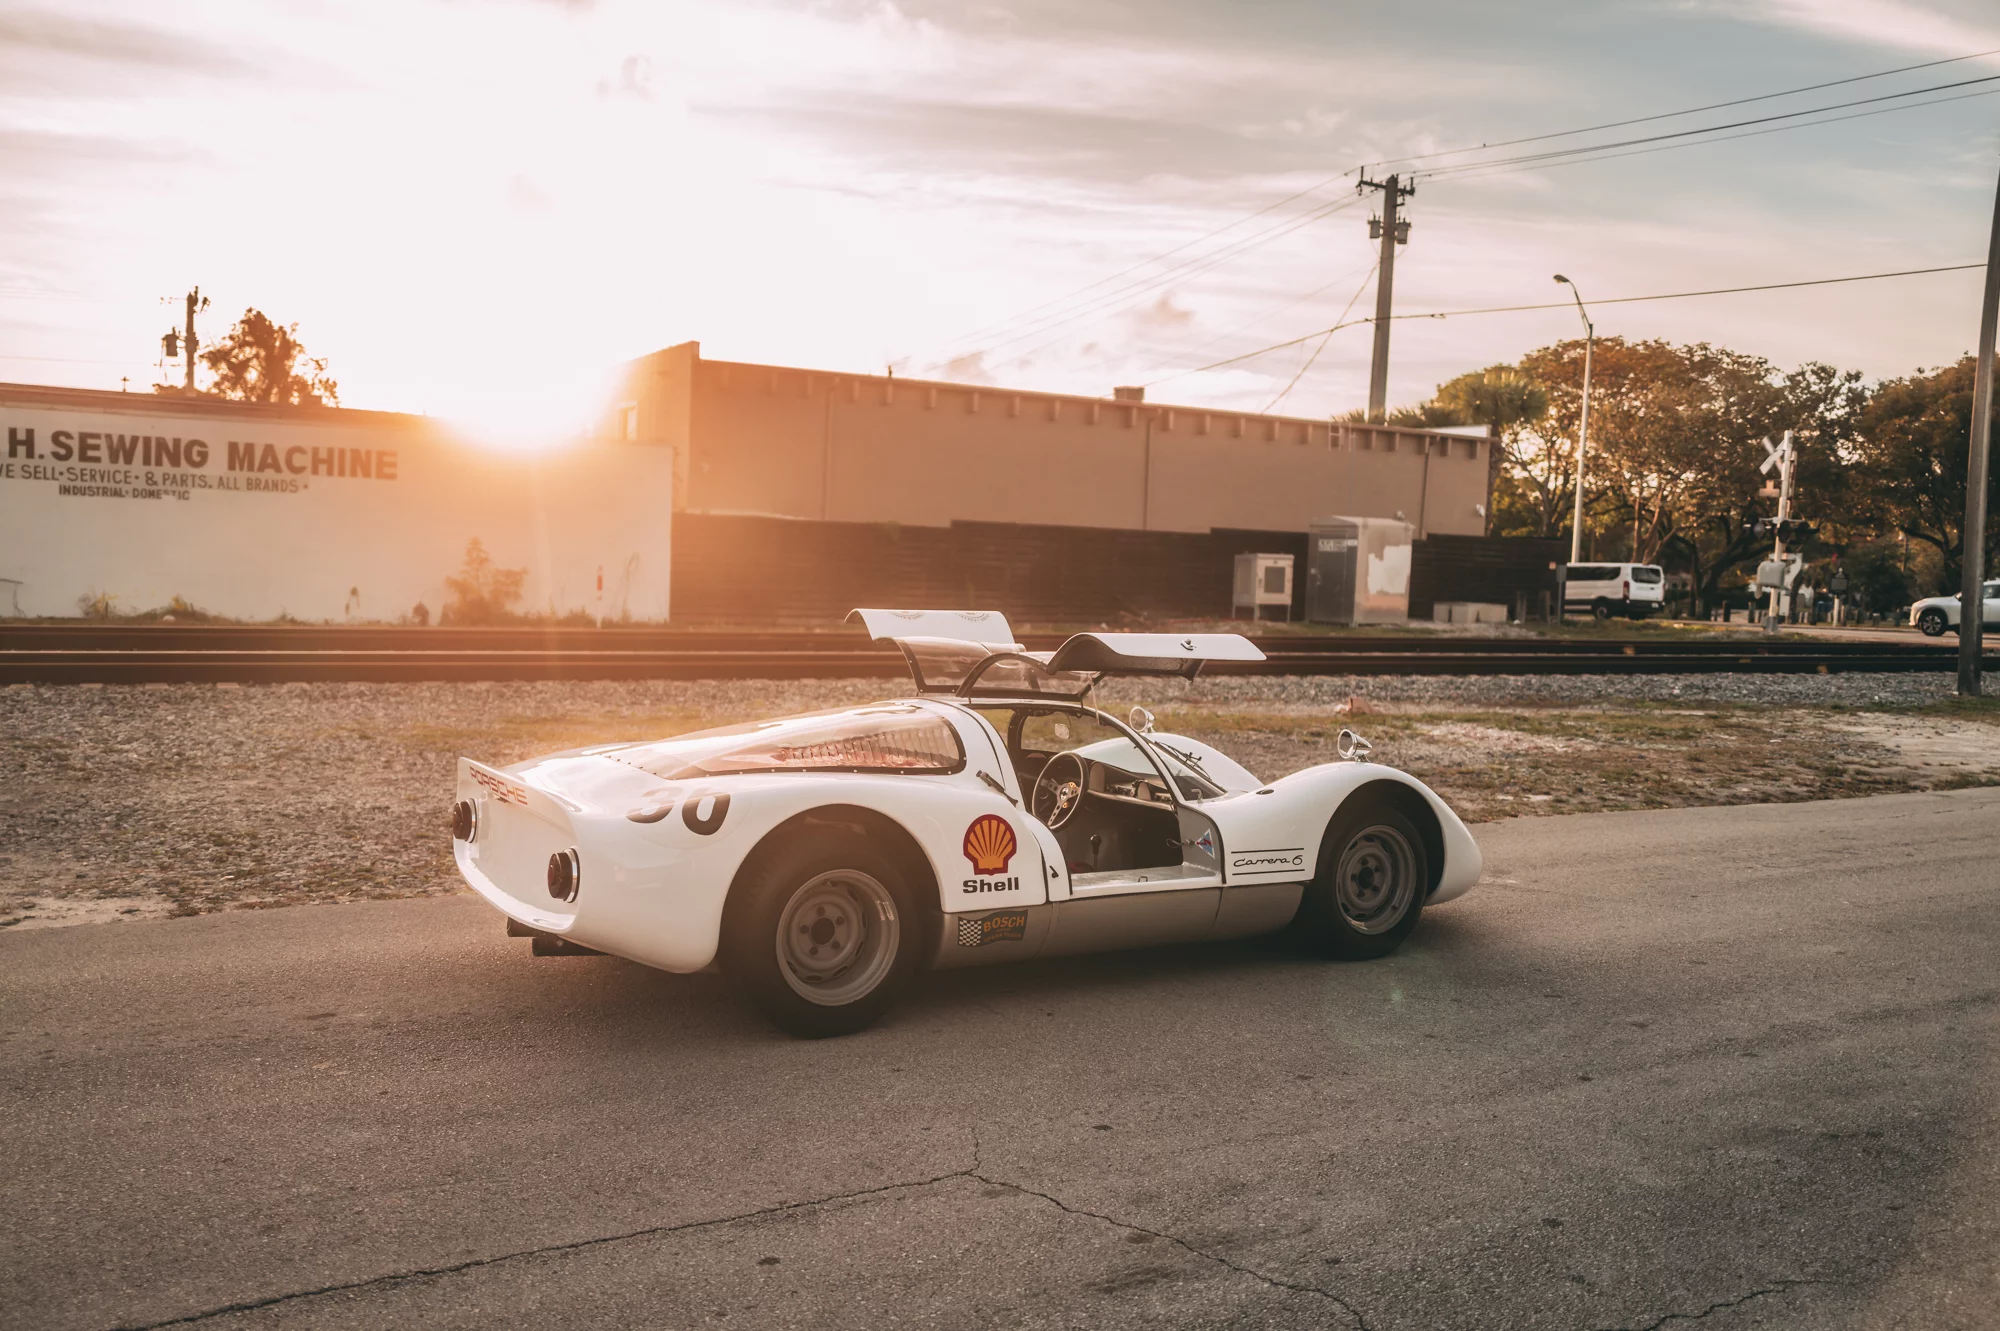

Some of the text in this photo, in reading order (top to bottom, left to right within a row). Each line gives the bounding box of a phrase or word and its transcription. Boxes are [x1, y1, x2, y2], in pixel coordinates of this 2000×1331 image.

[227, 440, 398, 481] MACHINE
[145, 471, 158, 487] &
[217, 476, 240, 491] ALL
[469, 765, 528, 806] PORSCHE
[625, 786, 731, 836] 30
[1292, 854, 1303, 866] 6
[962, 876, 1020, 894] Shell
[983, 915, 1026, 933] BOSCH
